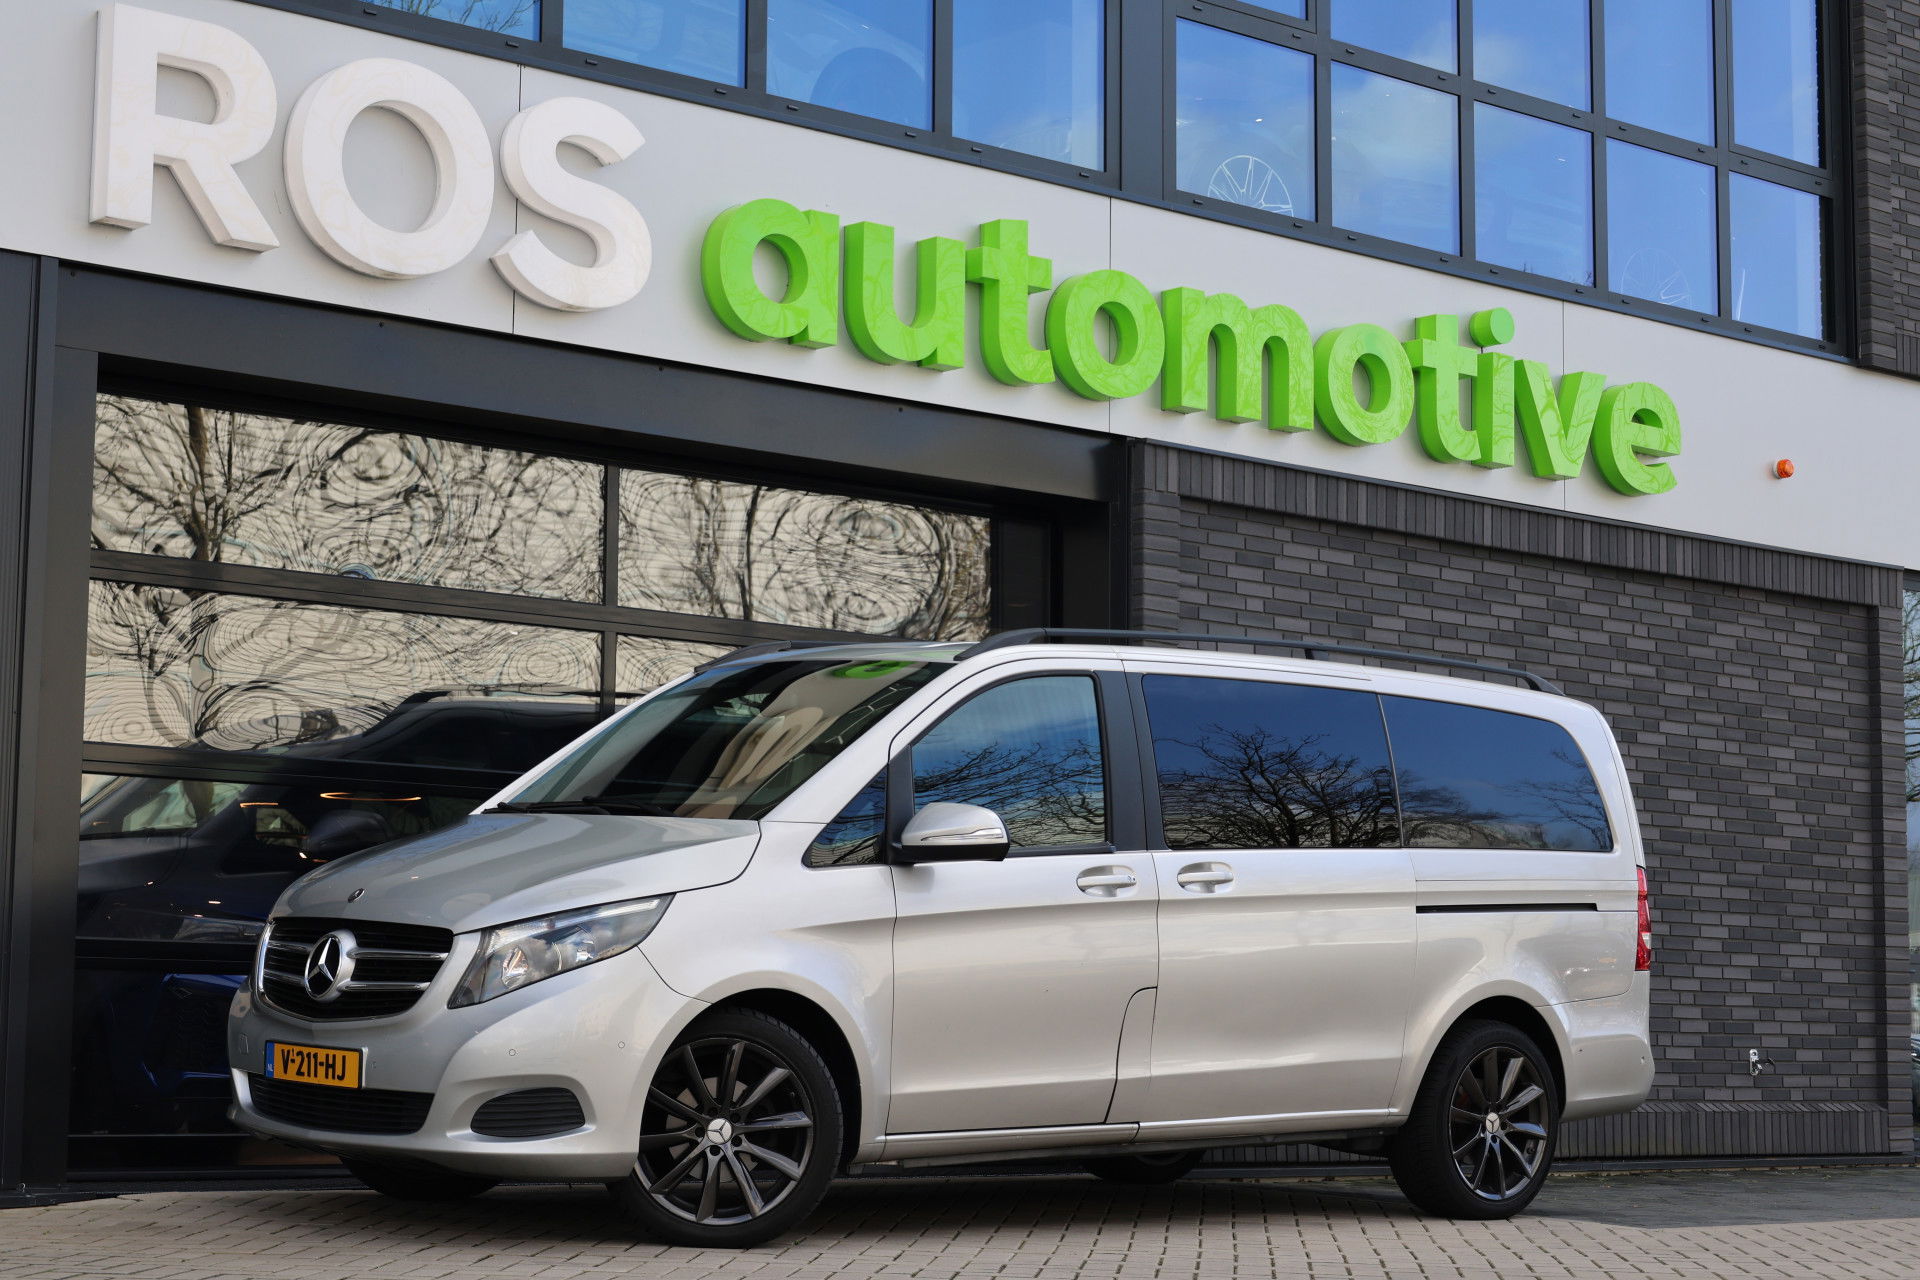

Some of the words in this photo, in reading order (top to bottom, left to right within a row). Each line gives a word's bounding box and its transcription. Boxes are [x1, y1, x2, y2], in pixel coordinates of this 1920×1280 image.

[90, 2, 651, 311] ROS
[700, 198, 1682, 496] automotive
[281, 1049, 346, 1081] V-211-HJ
